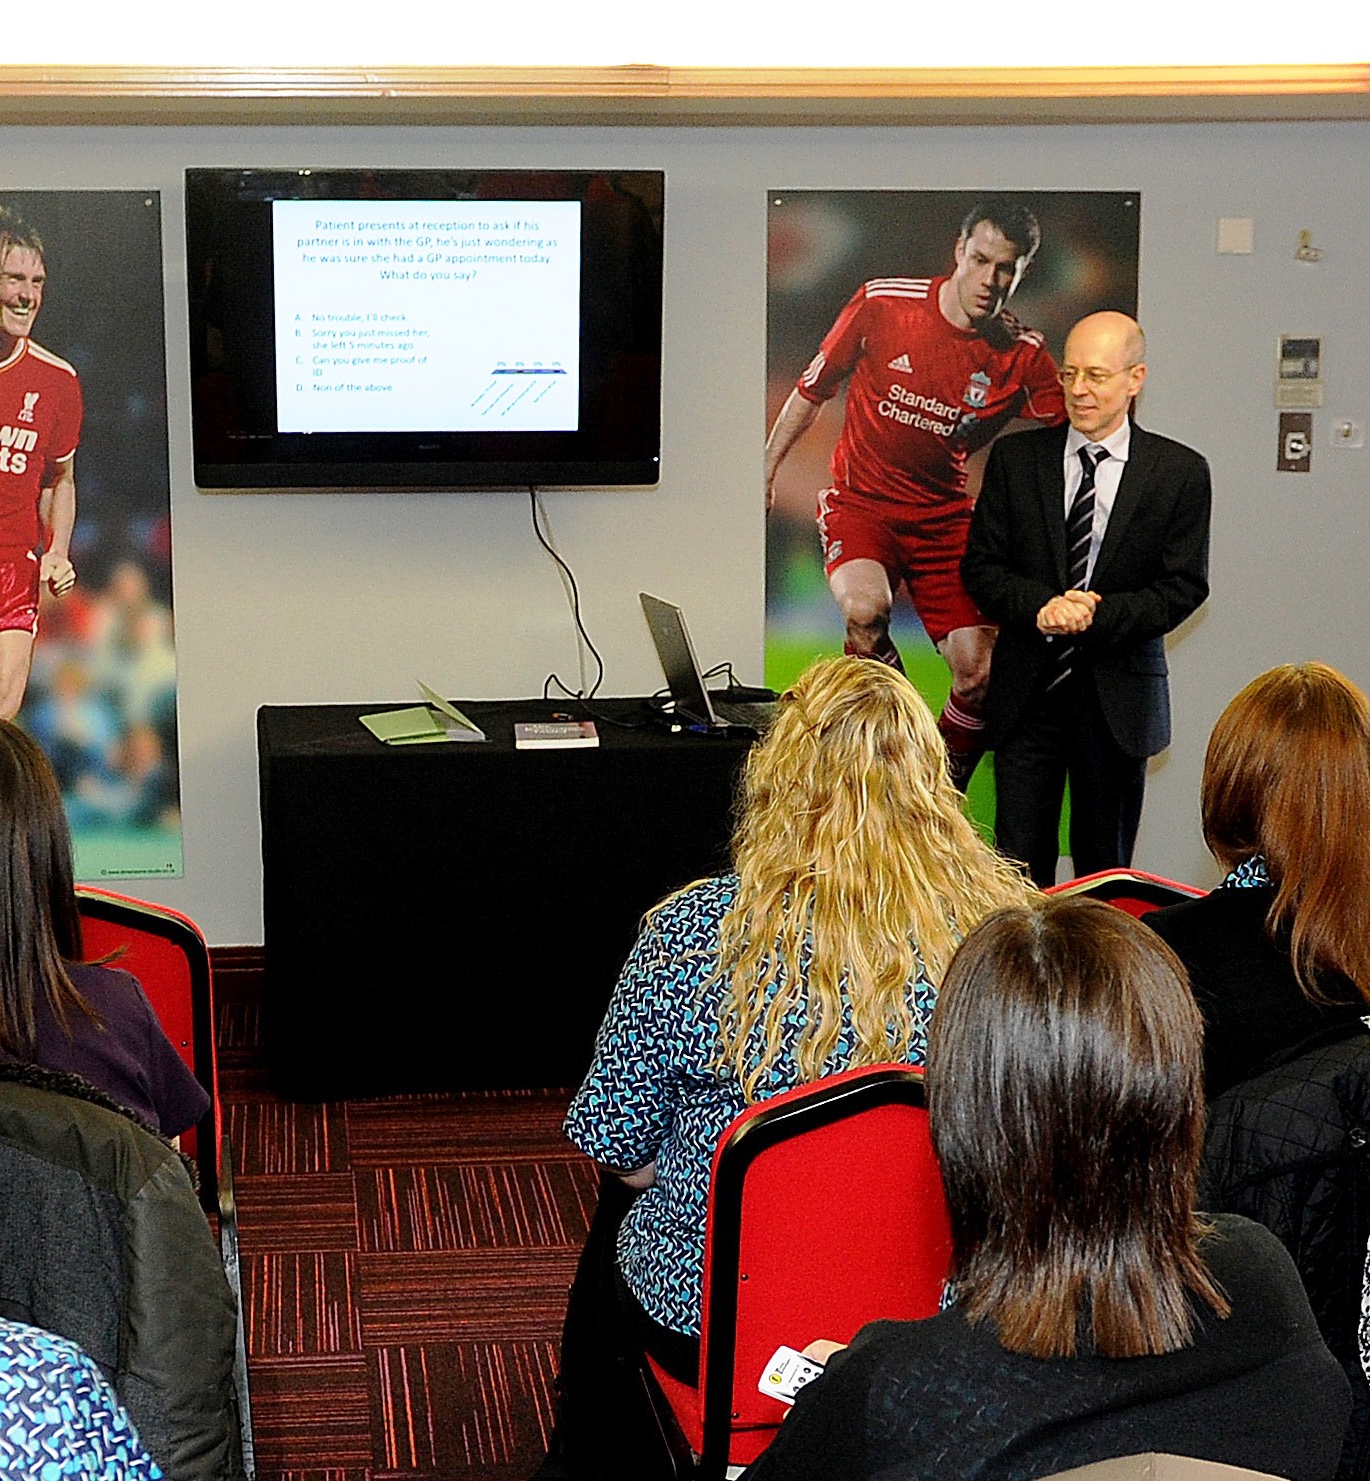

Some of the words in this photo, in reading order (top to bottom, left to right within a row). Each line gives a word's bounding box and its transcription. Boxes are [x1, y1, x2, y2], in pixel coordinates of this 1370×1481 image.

[315, 220, 355, 230] Patient
[358, 221, 405, 231] presents
[408, 221, 420, 230] at
[422, 221, 475, 231] reception
[478, 221, 490, 230] to
[493, 220, 510, 230] ask
[524, 220, 539, 230] his
[297, 238, 338, 248] partner
[342, 237, 350, 246] is
[353, 237, 364, 246] in
[367, 237, 391, 246] with
[394, 237, 413, 246] the
[460, 237, 481, 248] just
[485, 237, 544, 248] wondering
[302, 253, 316, 263] he
[319, 255, 341, 263] was
[344, 255, 368, 263] sure
[371, 253, 390, 263] she
[393, 253, 414, 262] had
[426, 253, 442, 263] GP
[445, 253, 516, 264] appointment
[379, 269, 410, 279] What
[412, 270, 427, 279] do
[430, 272, 450, 280] you
[454, 269, 477, 281] say?
[312, 329, 337, 338] Sorry
[888, 384, 961, 420] Standard
[878, 400, 955, 436] Chartered
